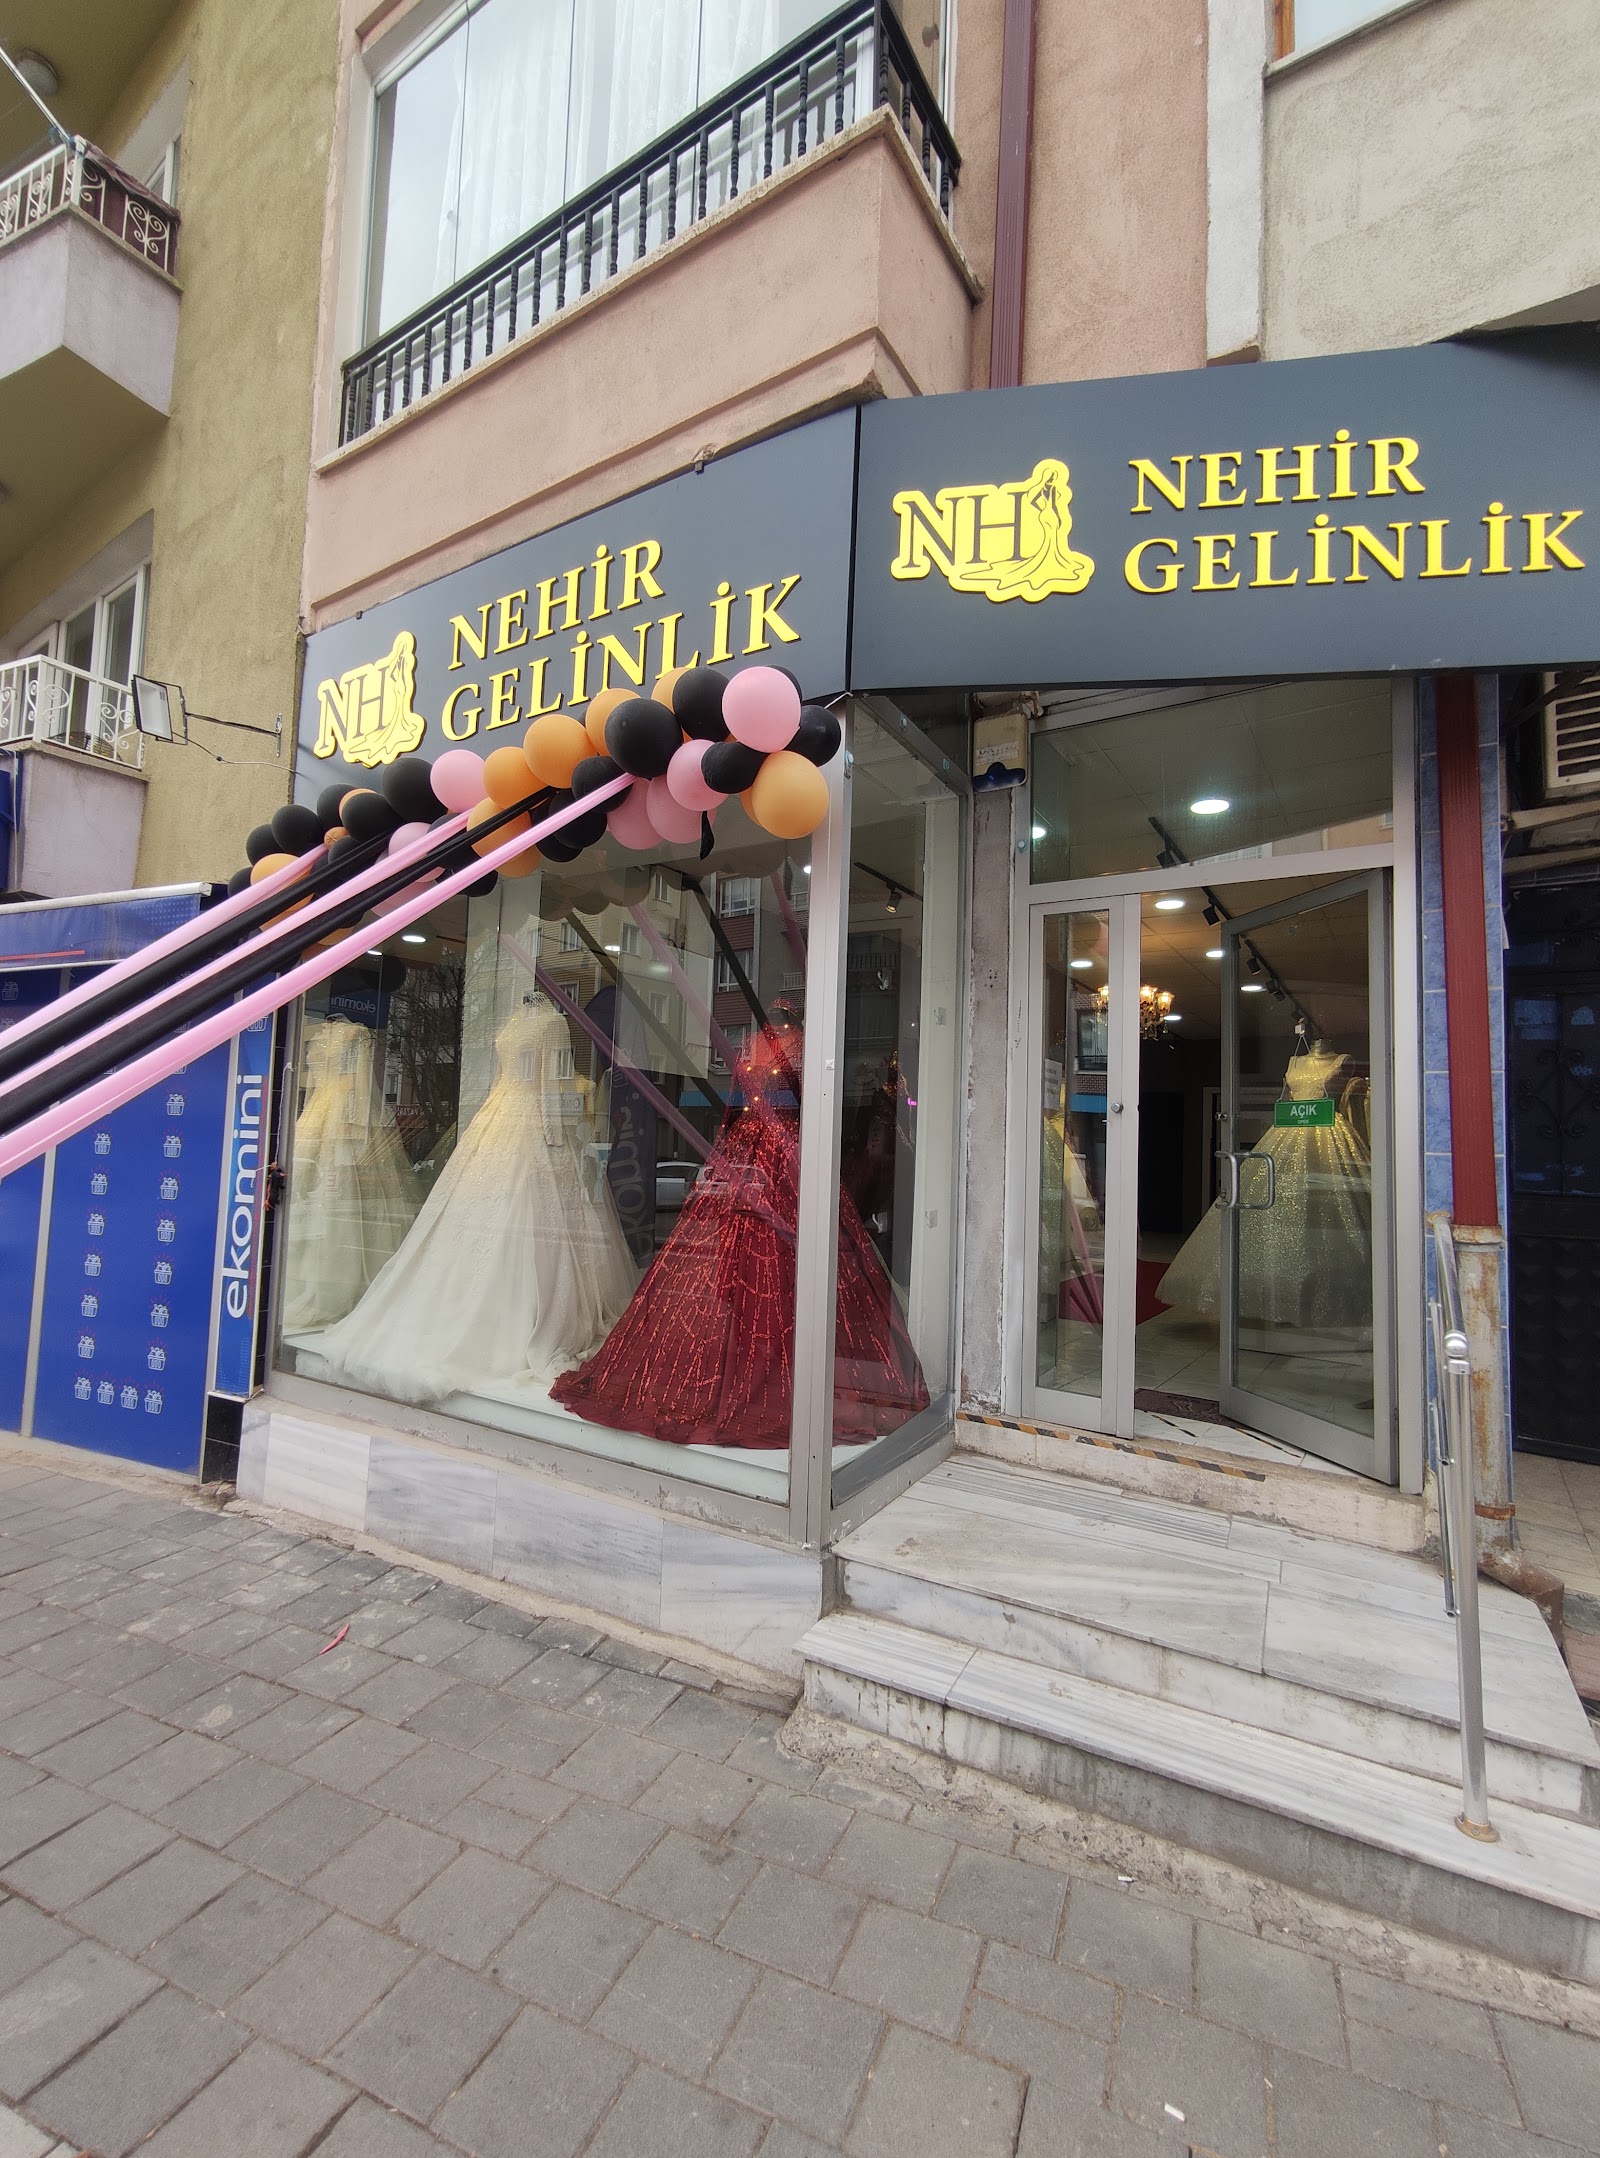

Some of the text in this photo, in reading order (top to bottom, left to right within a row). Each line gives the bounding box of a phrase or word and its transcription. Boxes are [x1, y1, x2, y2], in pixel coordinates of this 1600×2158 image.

[1129, 429, 1426, 514] NEHİR
[900, 488, 1032, 570] NH
[1124, 501, 1586, 595] GELİNLİK
[447, 540, 666, 671] NEHİR
[441, 574, 802, 742] GELİNLİK
[318, 664, 392, 752] NH
[1290, 1104, 1317, 1119] AÇIK
[222, 1074, 263, 1319] ekomini
